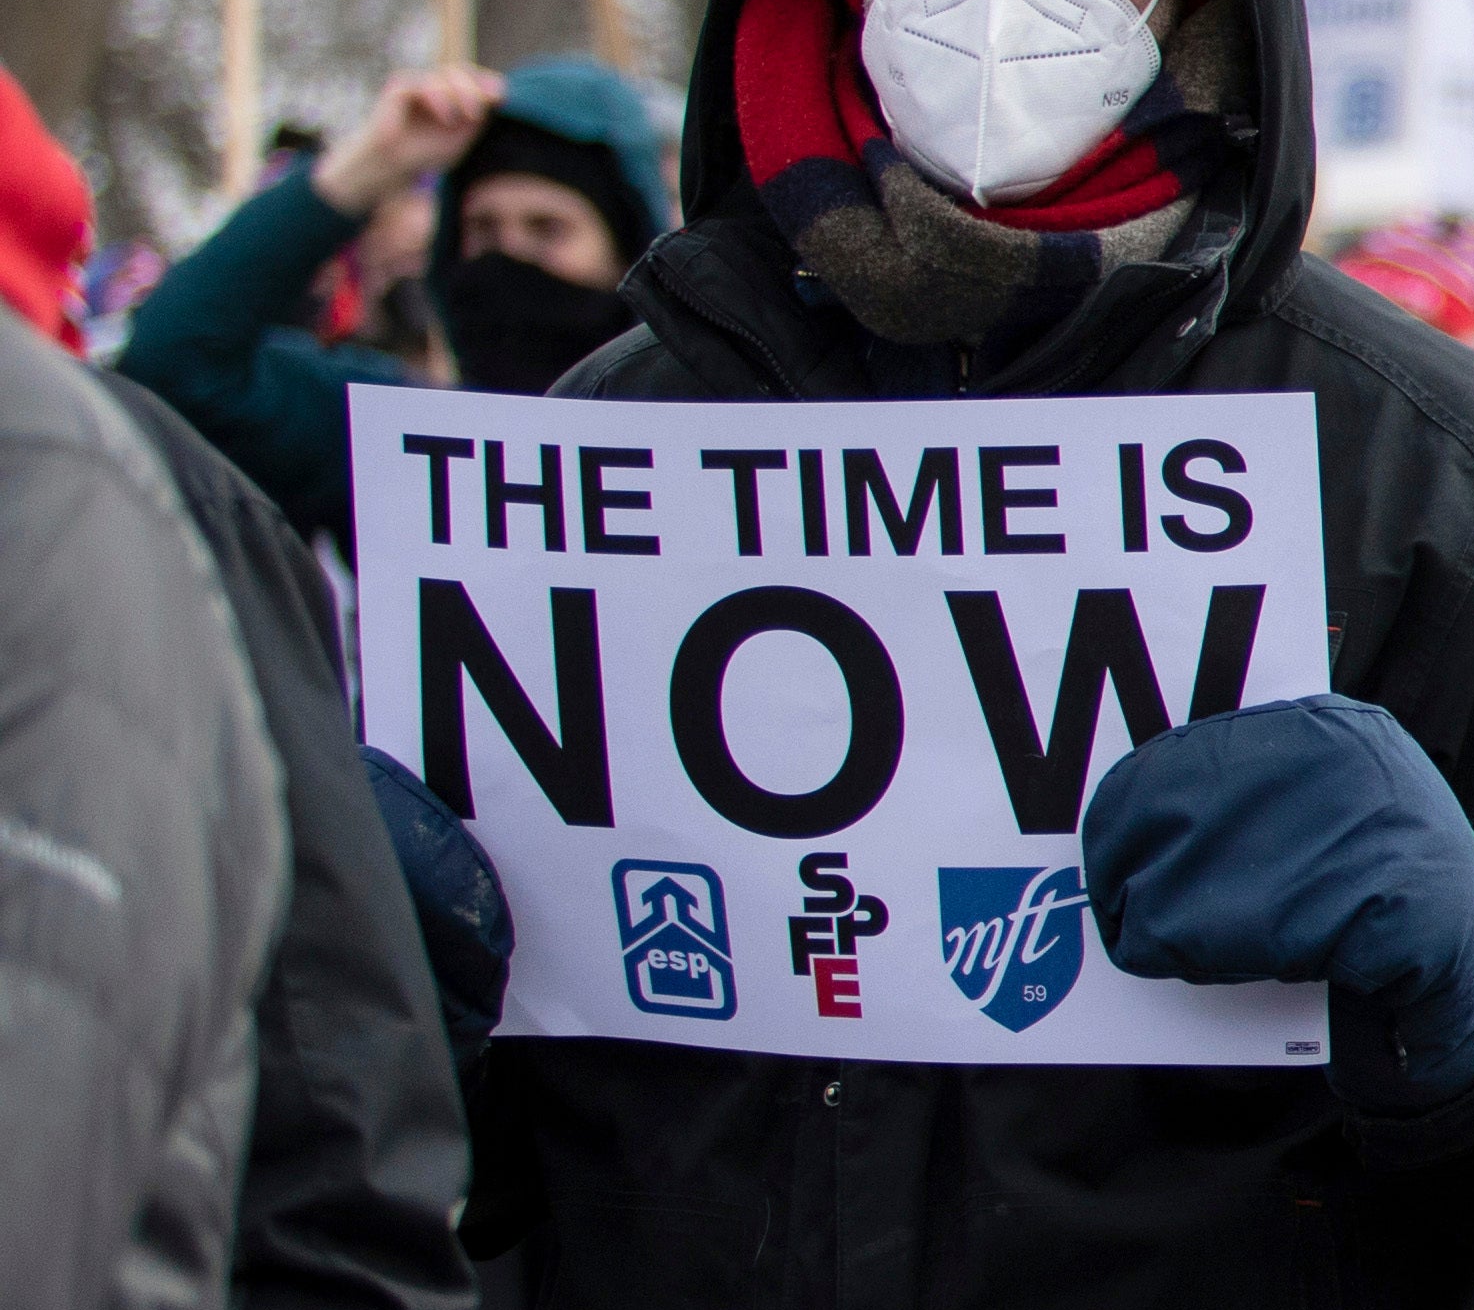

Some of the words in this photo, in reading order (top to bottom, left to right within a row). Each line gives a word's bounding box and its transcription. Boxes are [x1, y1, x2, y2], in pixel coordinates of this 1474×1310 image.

[403, 433, 661, 556] THE
[700, 446, 1066, 557] TIME
[1118, 438, 1254, 553] IS
[418, 577, 1267, 839] NOW
[648, 944, 710, 980] esp
[1022, 985, 1048, 1004] 59
